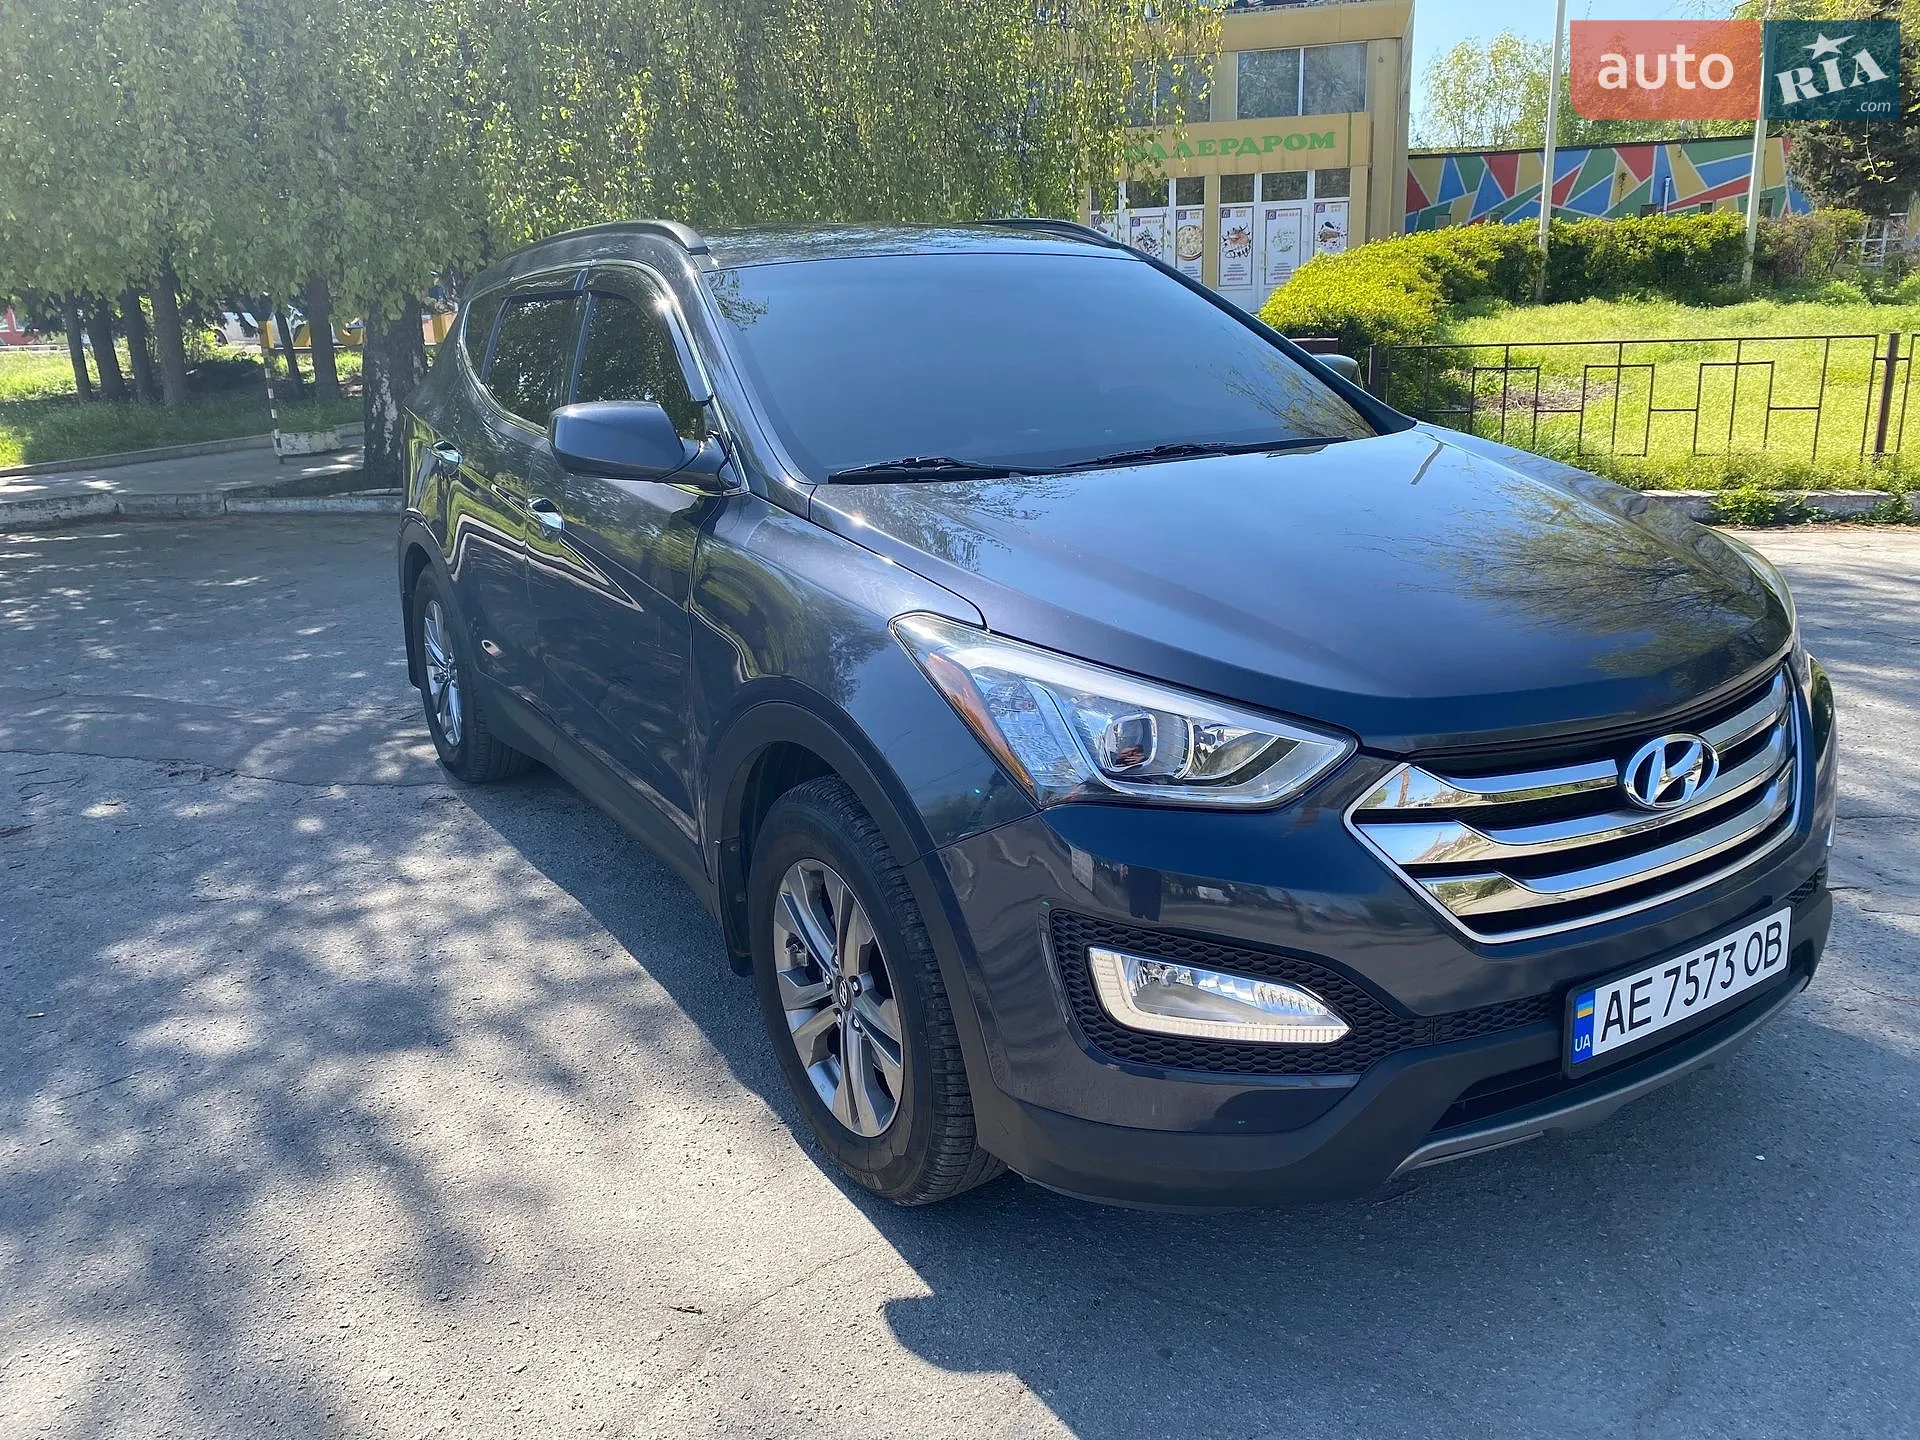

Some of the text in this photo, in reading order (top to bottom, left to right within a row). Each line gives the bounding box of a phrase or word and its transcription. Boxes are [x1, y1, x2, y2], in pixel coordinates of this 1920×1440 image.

[1600, 920, 1783, 1043] AE 7573 OB
[1574, 1033, 1591, 1052] UA
